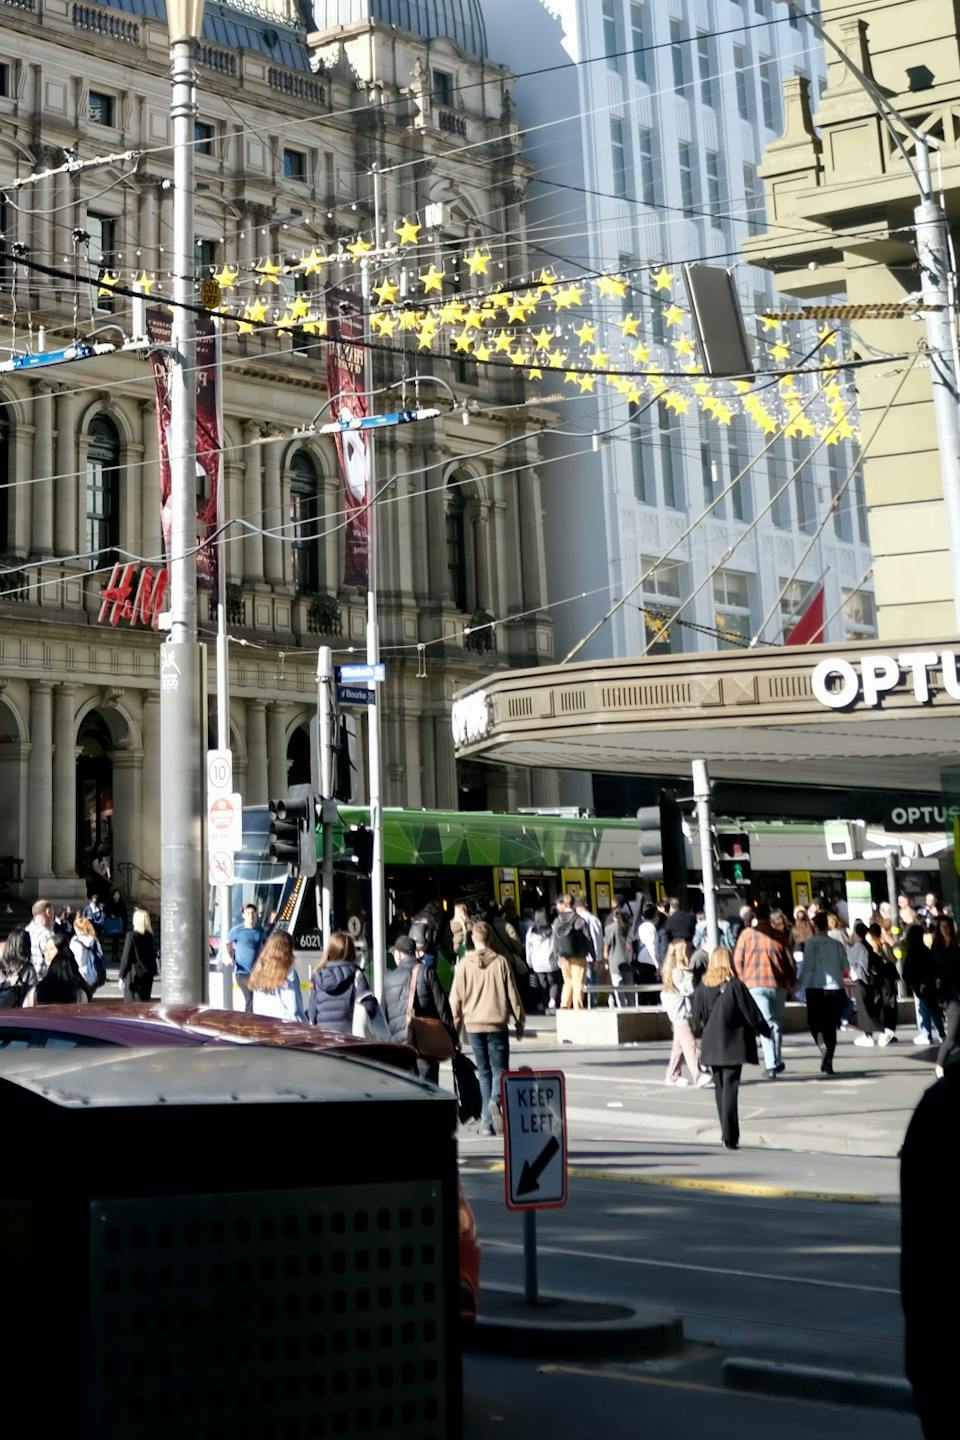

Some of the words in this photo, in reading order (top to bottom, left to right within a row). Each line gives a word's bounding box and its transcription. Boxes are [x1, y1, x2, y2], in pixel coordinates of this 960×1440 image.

[203, 283, 218, 294] CUT
[203, 295, 218, 305] OFF
[214, 765, 226, 781] 10
[300, 935, 320, 948] 6021
[517, 1088, 554, 1108] KEEP
[521, 1113, 554, 1133] LEFT
